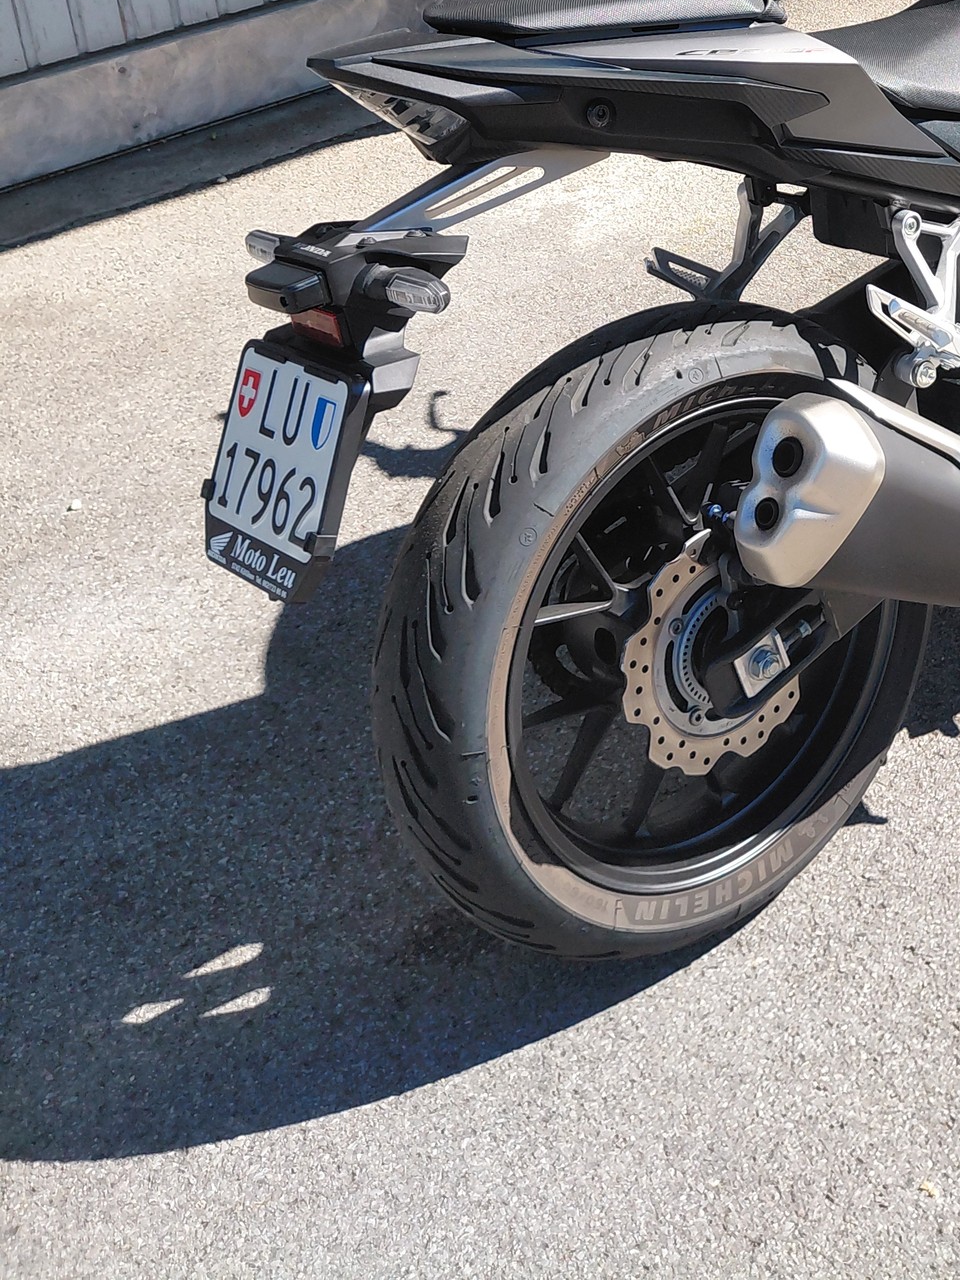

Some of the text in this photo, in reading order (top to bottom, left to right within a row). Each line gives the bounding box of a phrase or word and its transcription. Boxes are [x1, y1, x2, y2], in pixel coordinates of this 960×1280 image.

[258, 365, 311, 447] LU
[216, 441, 317, 545] 17962
[230, 534, 267, 572] Moto
[266, 553, 296, 589] Leu
[634, 837, 795, 920] MICHELIN
